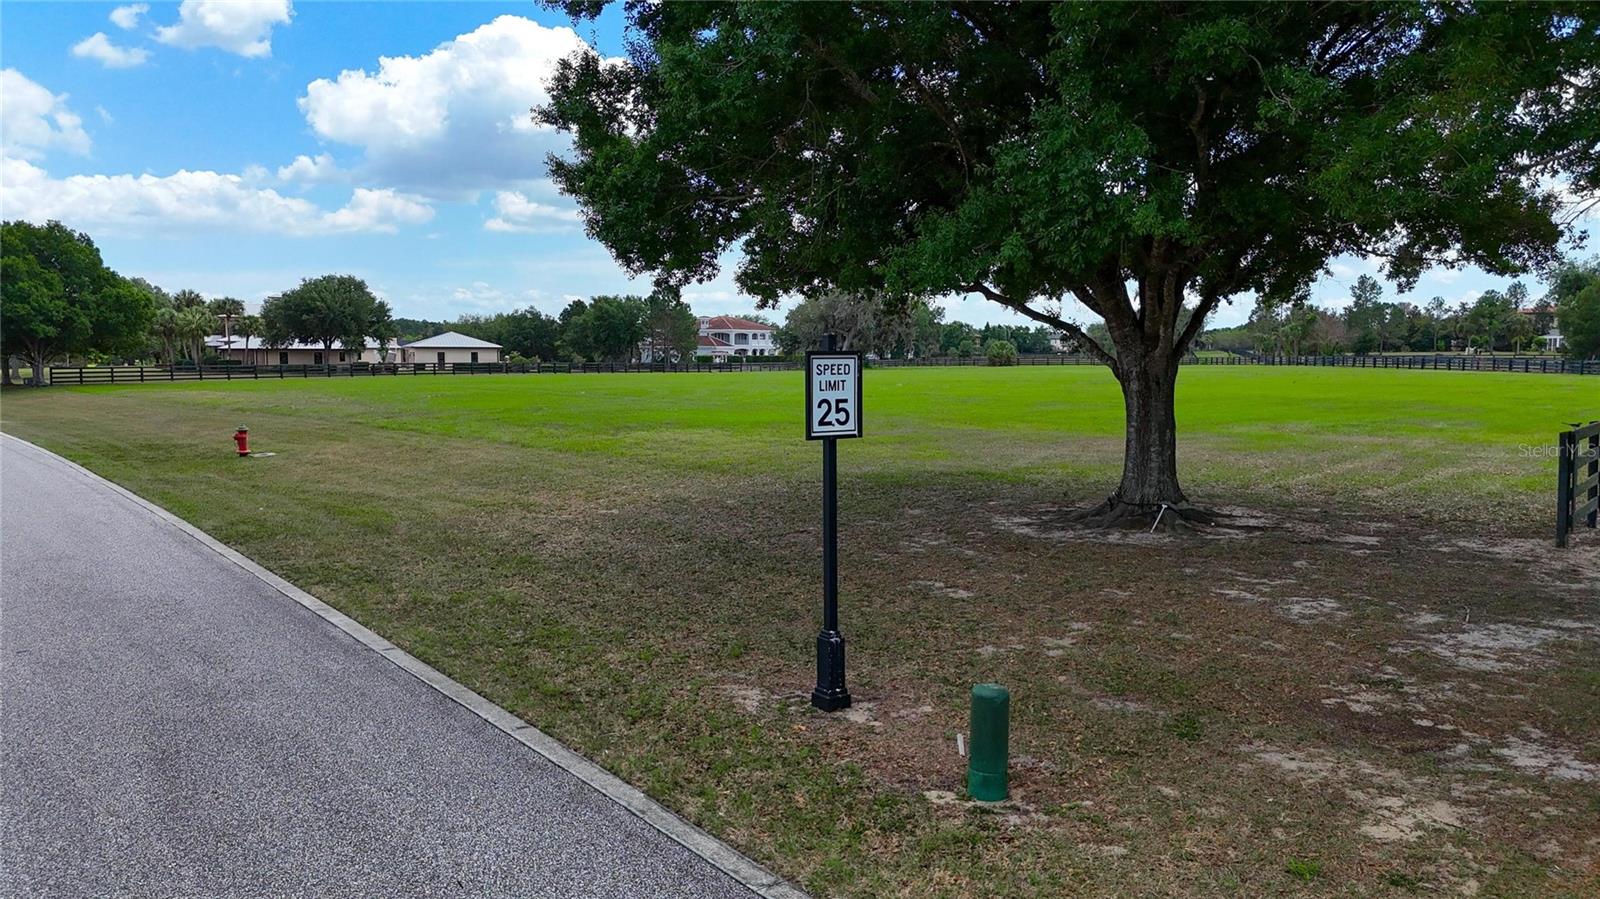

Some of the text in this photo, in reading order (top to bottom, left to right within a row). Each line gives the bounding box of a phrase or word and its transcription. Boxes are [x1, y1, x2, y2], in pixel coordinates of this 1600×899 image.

[816, 363, 850, 376] SPEED
[819, 379, 846, 392] LIMIT
[817, 398, 850, 427] 25
